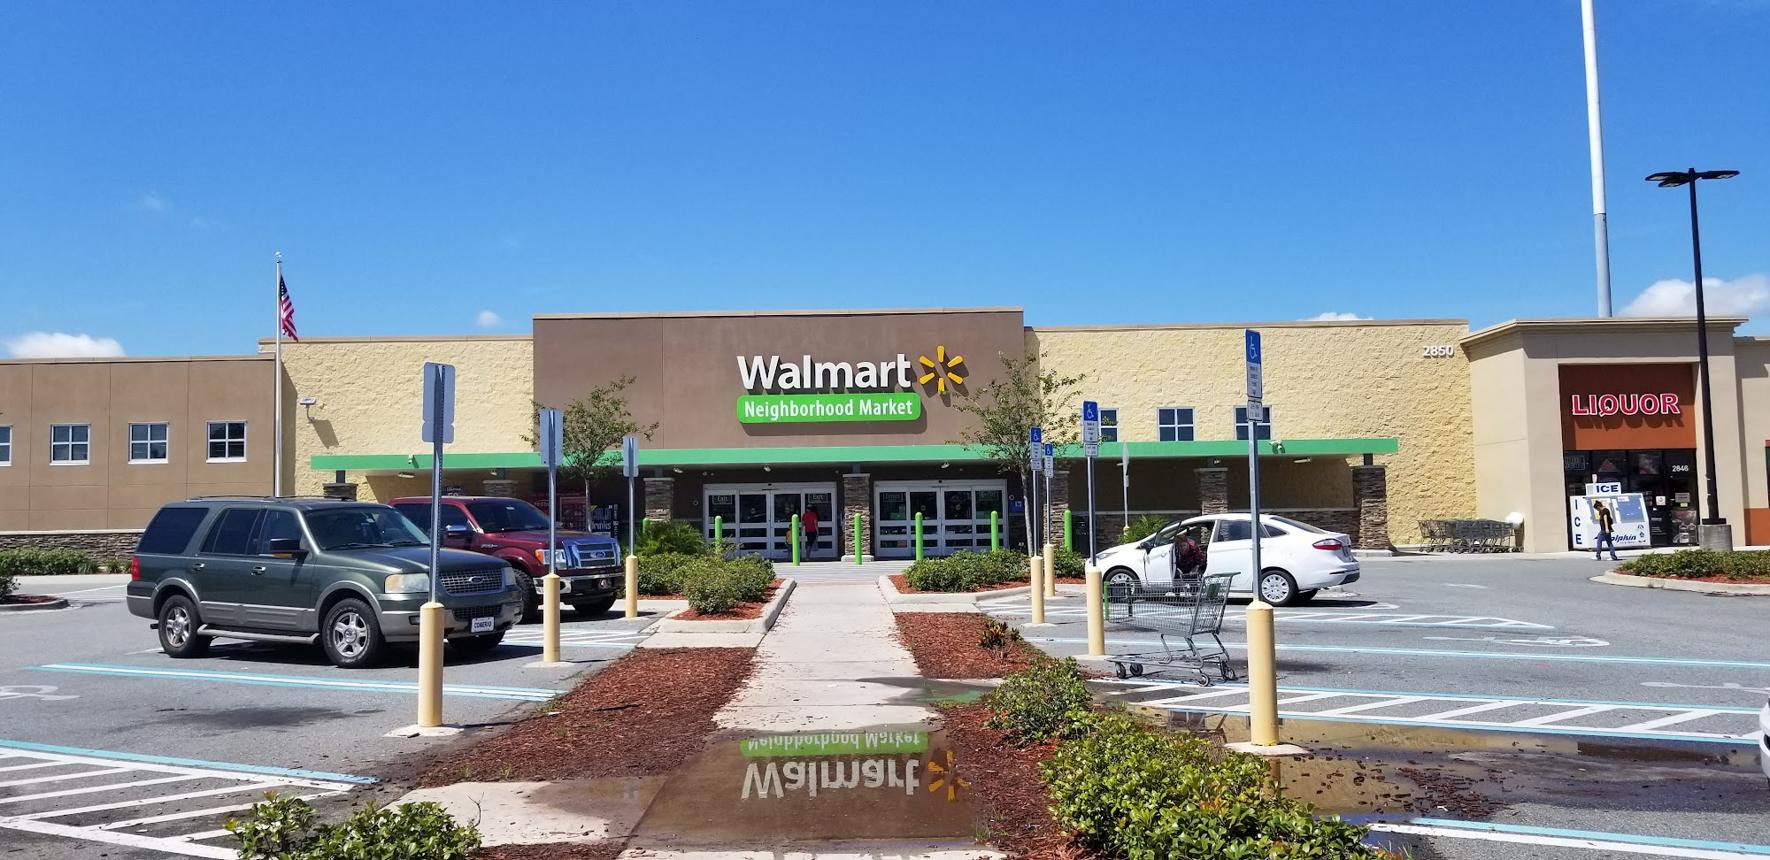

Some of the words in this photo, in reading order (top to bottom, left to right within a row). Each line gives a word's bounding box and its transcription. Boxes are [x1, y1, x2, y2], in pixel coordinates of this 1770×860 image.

[1423, 345, 1454, 358] 2850
[736, 353, 912, 390] Walmart
[744, 399, 854, 421] Neighborhood
[859, 398, 913, 416] Market
[1572, 393, 1680, 418] LIQUOR
[1672, 465, 1689, 473] 2846
[1596, 484, 1619, 493] ICE
